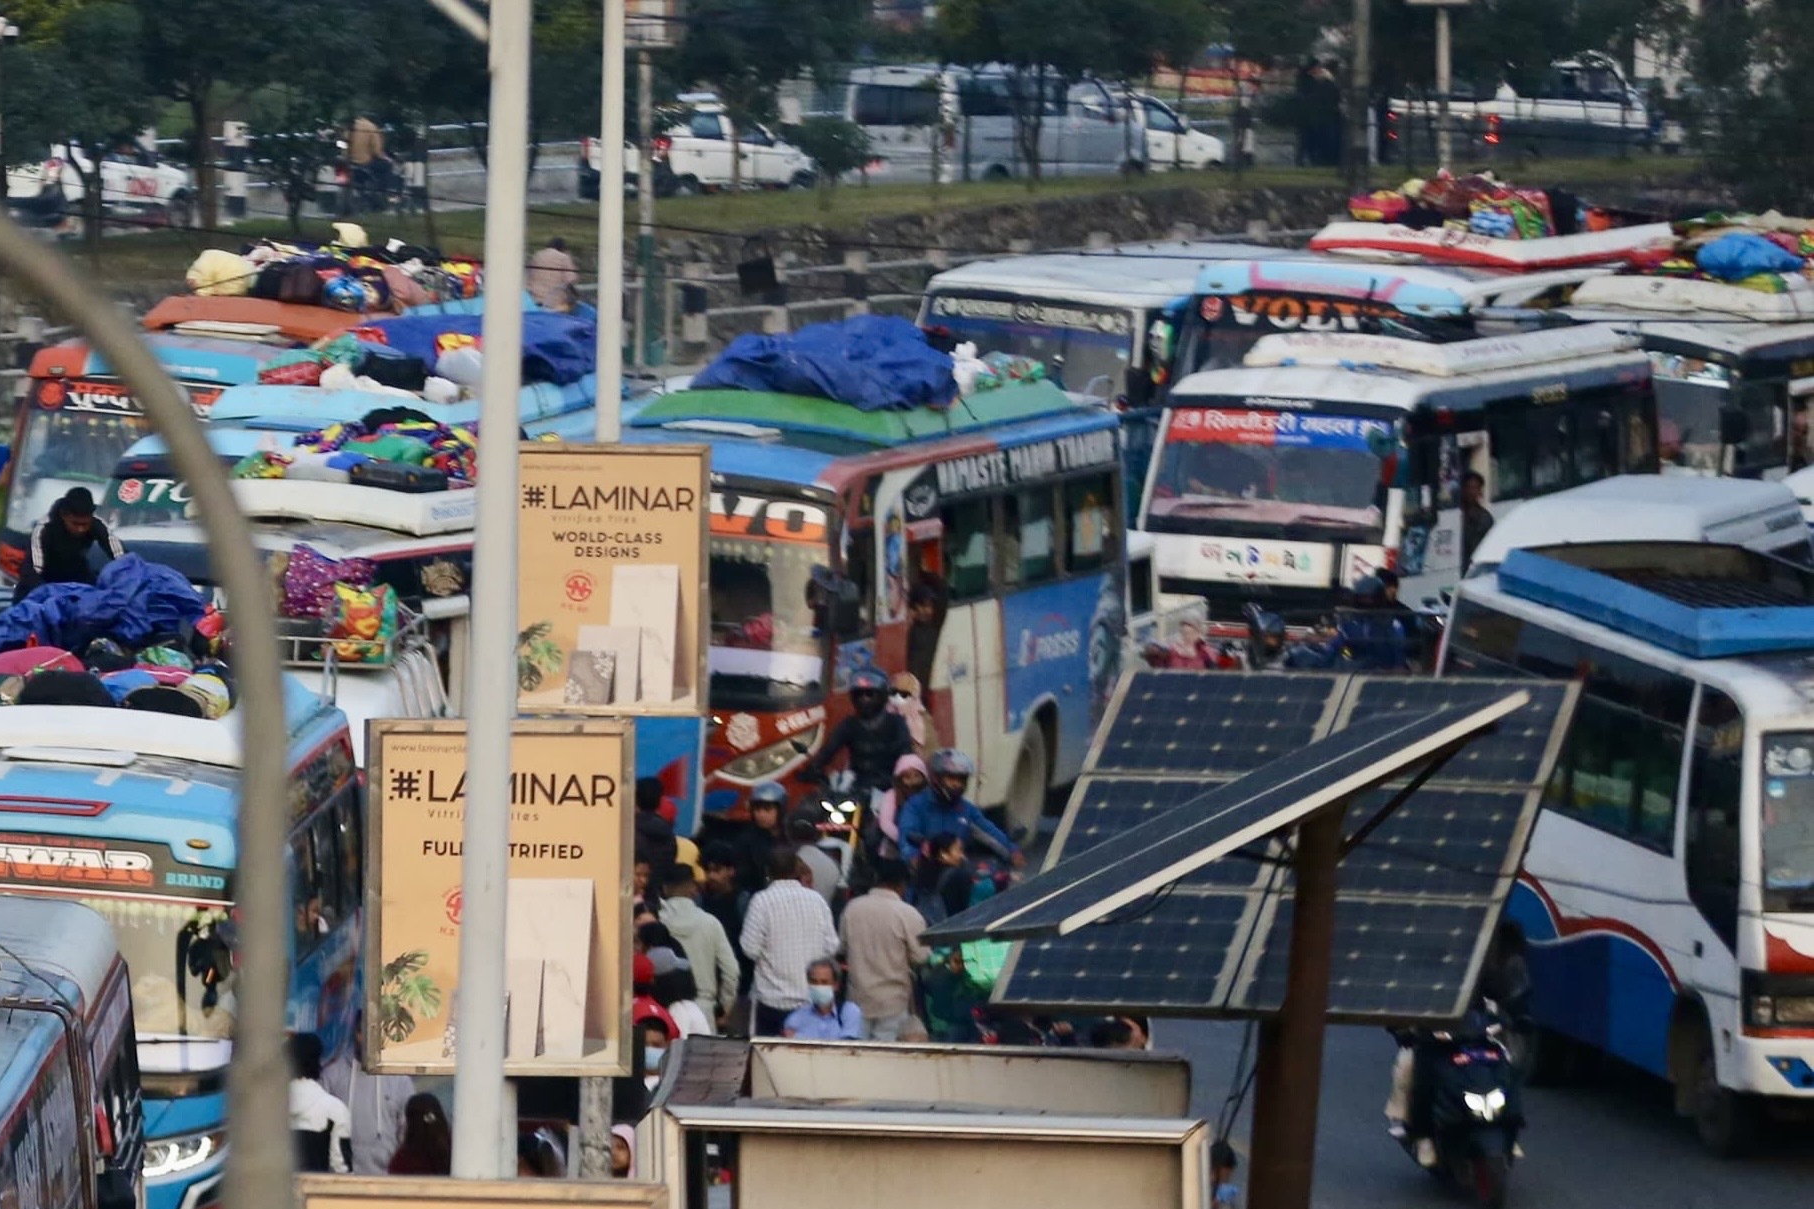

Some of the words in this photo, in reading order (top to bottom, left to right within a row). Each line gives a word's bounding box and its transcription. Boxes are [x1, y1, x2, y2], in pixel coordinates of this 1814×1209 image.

[553, 531, 663, 545] WORLD-CLASS
[575, 547, 640, 559] DESIGNS
[165, 872, 226, 890] BRAND
